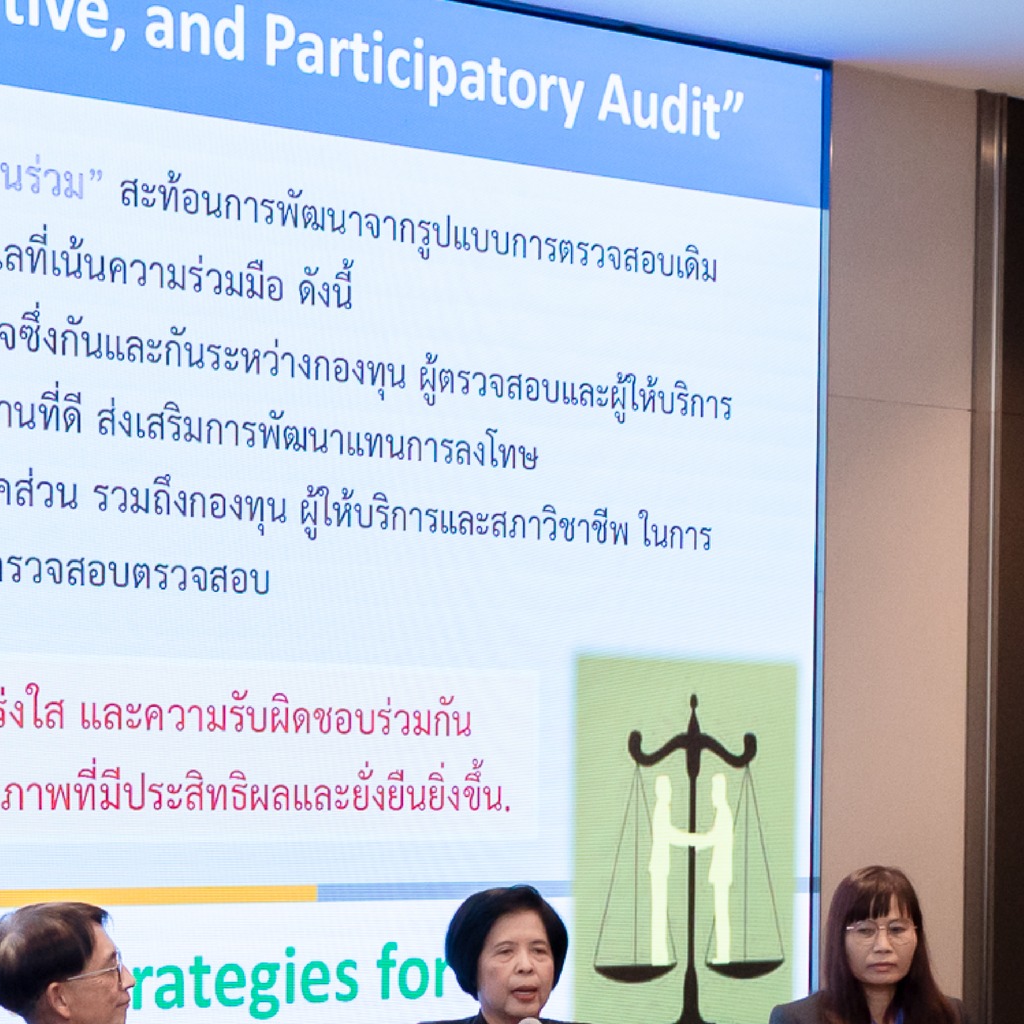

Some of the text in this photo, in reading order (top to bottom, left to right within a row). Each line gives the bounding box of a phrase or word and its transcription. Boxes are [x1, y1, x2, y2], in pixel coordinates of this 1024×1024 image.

[146, 7, 244, 60] and
[267, 14, 584, 128] Participatory
[120, 171, 717, 283] สะท้อนการพัฒนาจากรูปแบบการตรวจสอบเดิม
[298, 258, 355, 311] ดังนี้
[420, 352, 733, 422] ผู้ตรวจสอบและผู้ให้บริการ
[97, 397, 539, 471] ส่งเสริมการพัฒนาแทนการลงโทษ
[93, 474, 289, 537] รวมถึงกองทุน
[300, 485, 629, 546] ผู้ให้บริการและสภาวิชาชีพ
[638, 509, 712, 551] ในการ
[81, 690, 471, 737] และความรับผิดชอบร่วมกัน
[376, 941, 448, 1000] for
